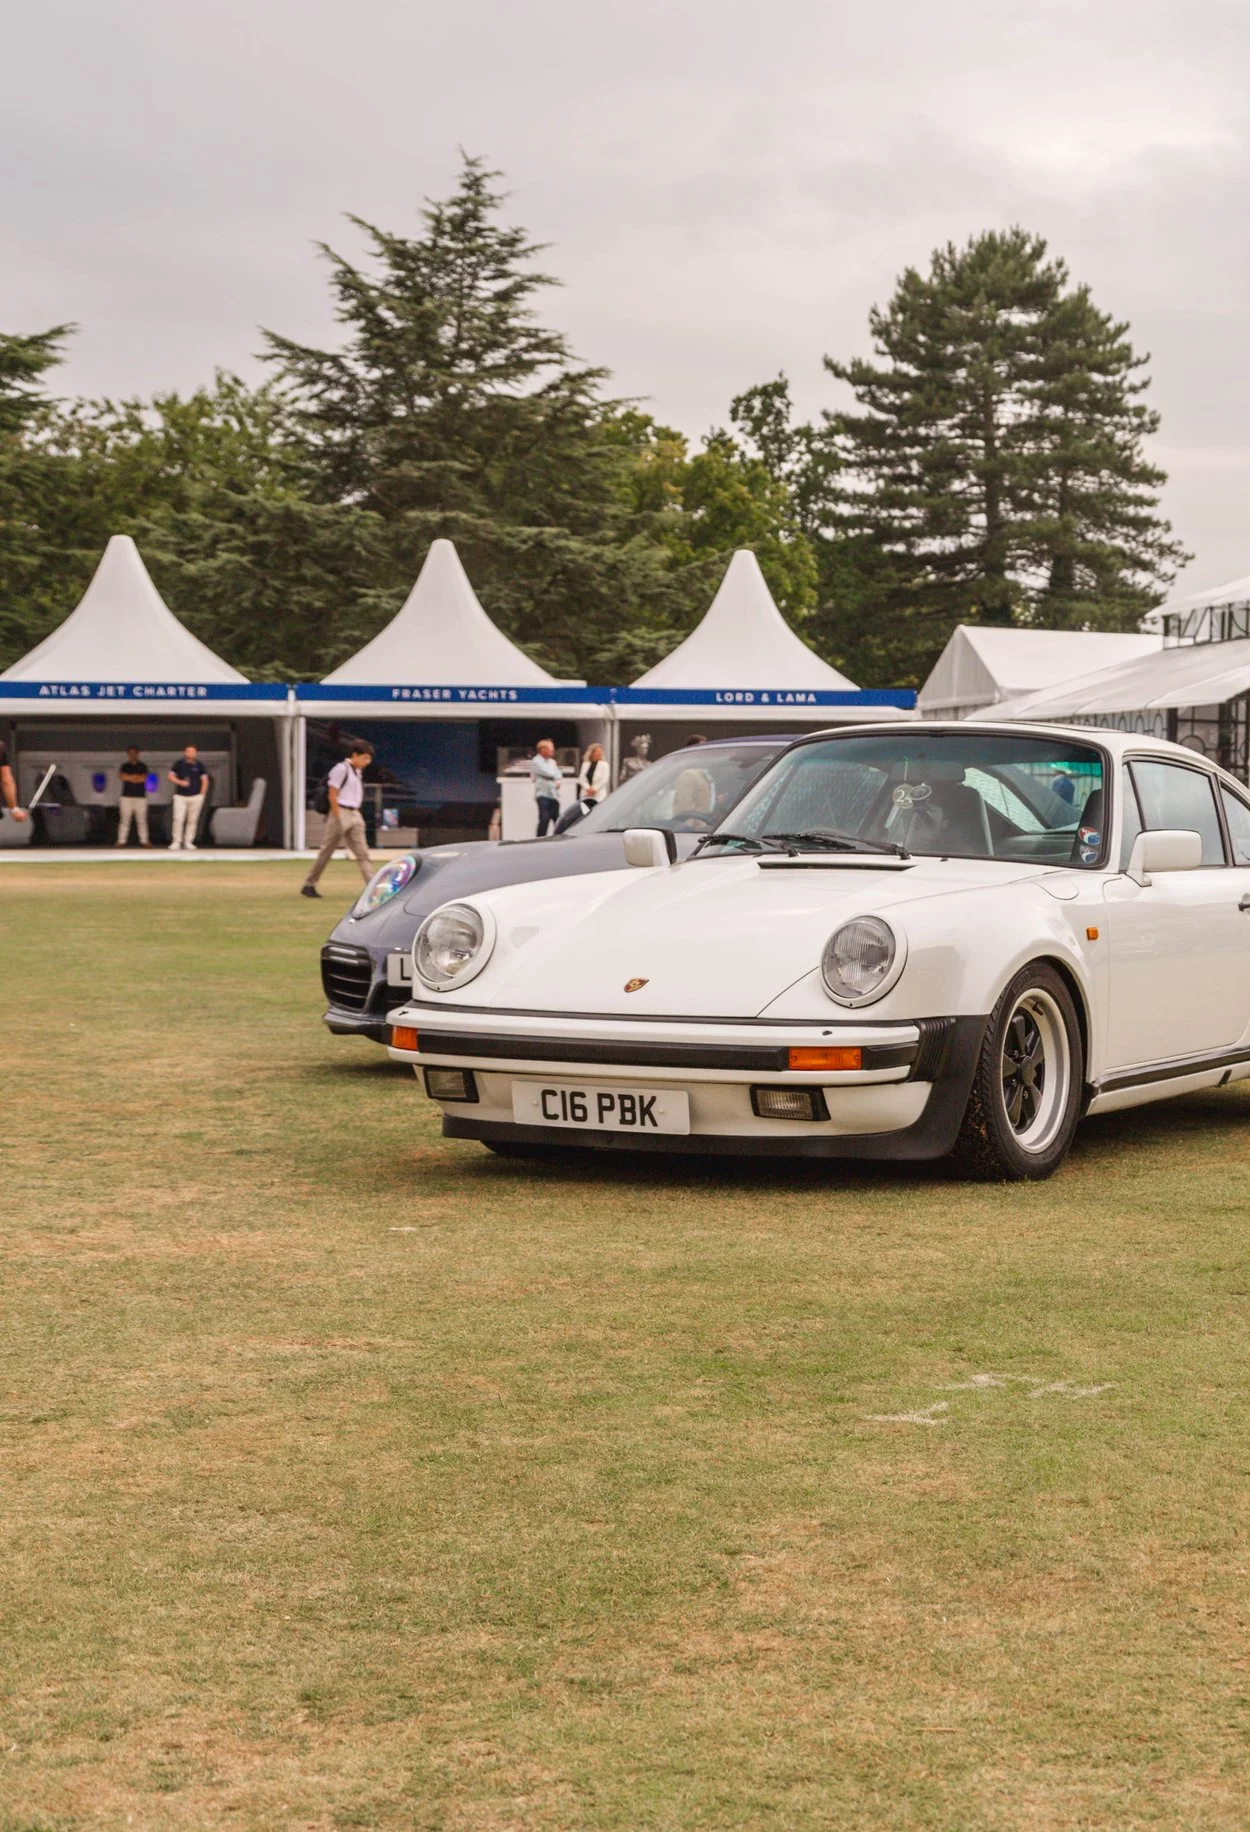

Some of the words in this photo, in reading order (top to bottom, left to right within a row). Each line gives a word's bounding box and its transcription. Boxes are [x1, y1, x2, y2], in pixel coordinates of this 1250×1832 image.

[38, 684, 91, 697] ATLAS
[97, 685, 126, 697] JET
[132, 685, 209, 698] CHARTER
[391, 687, 452, 700] FRASER
[457, 688, 519, 701] YACHTS
[715, 691, 755, 703] LORD
[760, 692, 770, 703] &
[776, 692, 817, 704] LAMA
[541, 1089, 588, 1123] C16
[597, 1092, 659, 1128] PBK
